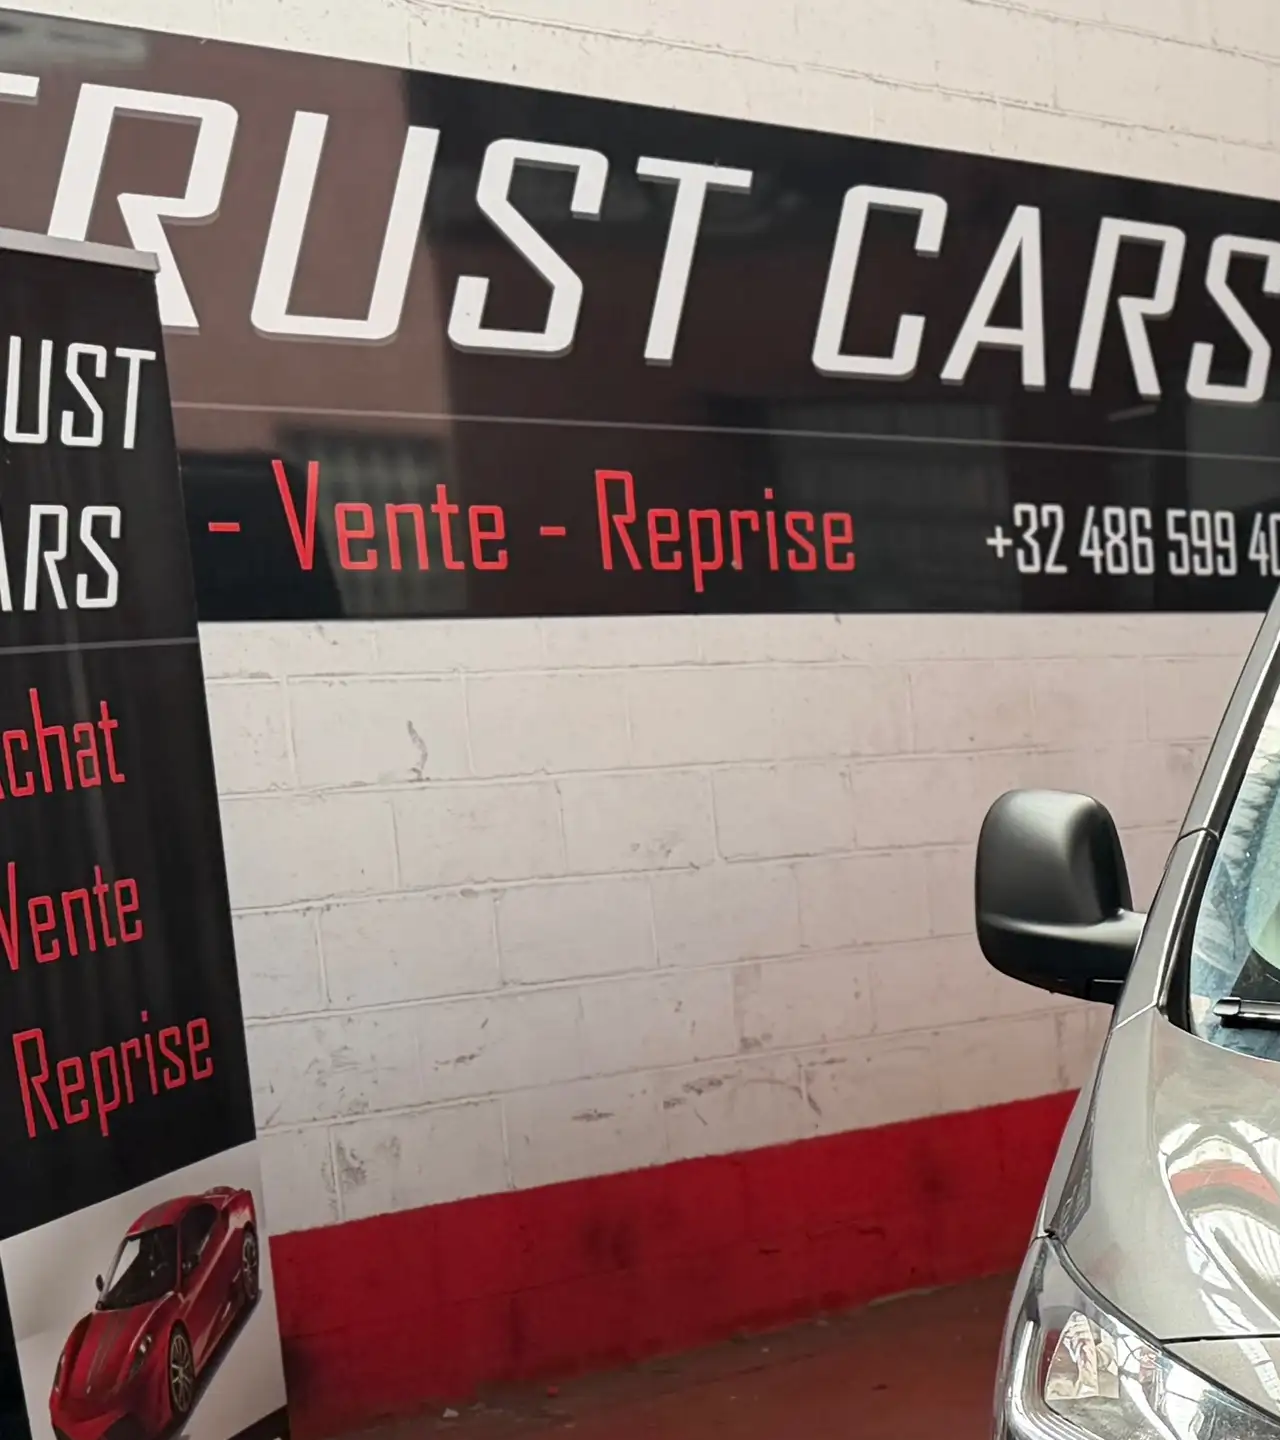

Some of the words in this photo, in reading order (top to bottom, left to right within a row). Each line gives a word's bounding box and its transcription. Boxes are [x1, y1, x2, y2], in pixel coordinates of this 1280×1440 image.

[0, 72, 753, 366] RUST
[272, 459, 510, 573] Vente
[595, 468, 856, 594] Reprise
[986, 504, 1068, 574] +32
[1079, 505, 1155, 575] 486
[1166, 509, 1238, 576] 599
[0, 687, 126, 799] chat
[12, 1010, 214, 1139] Reprise
